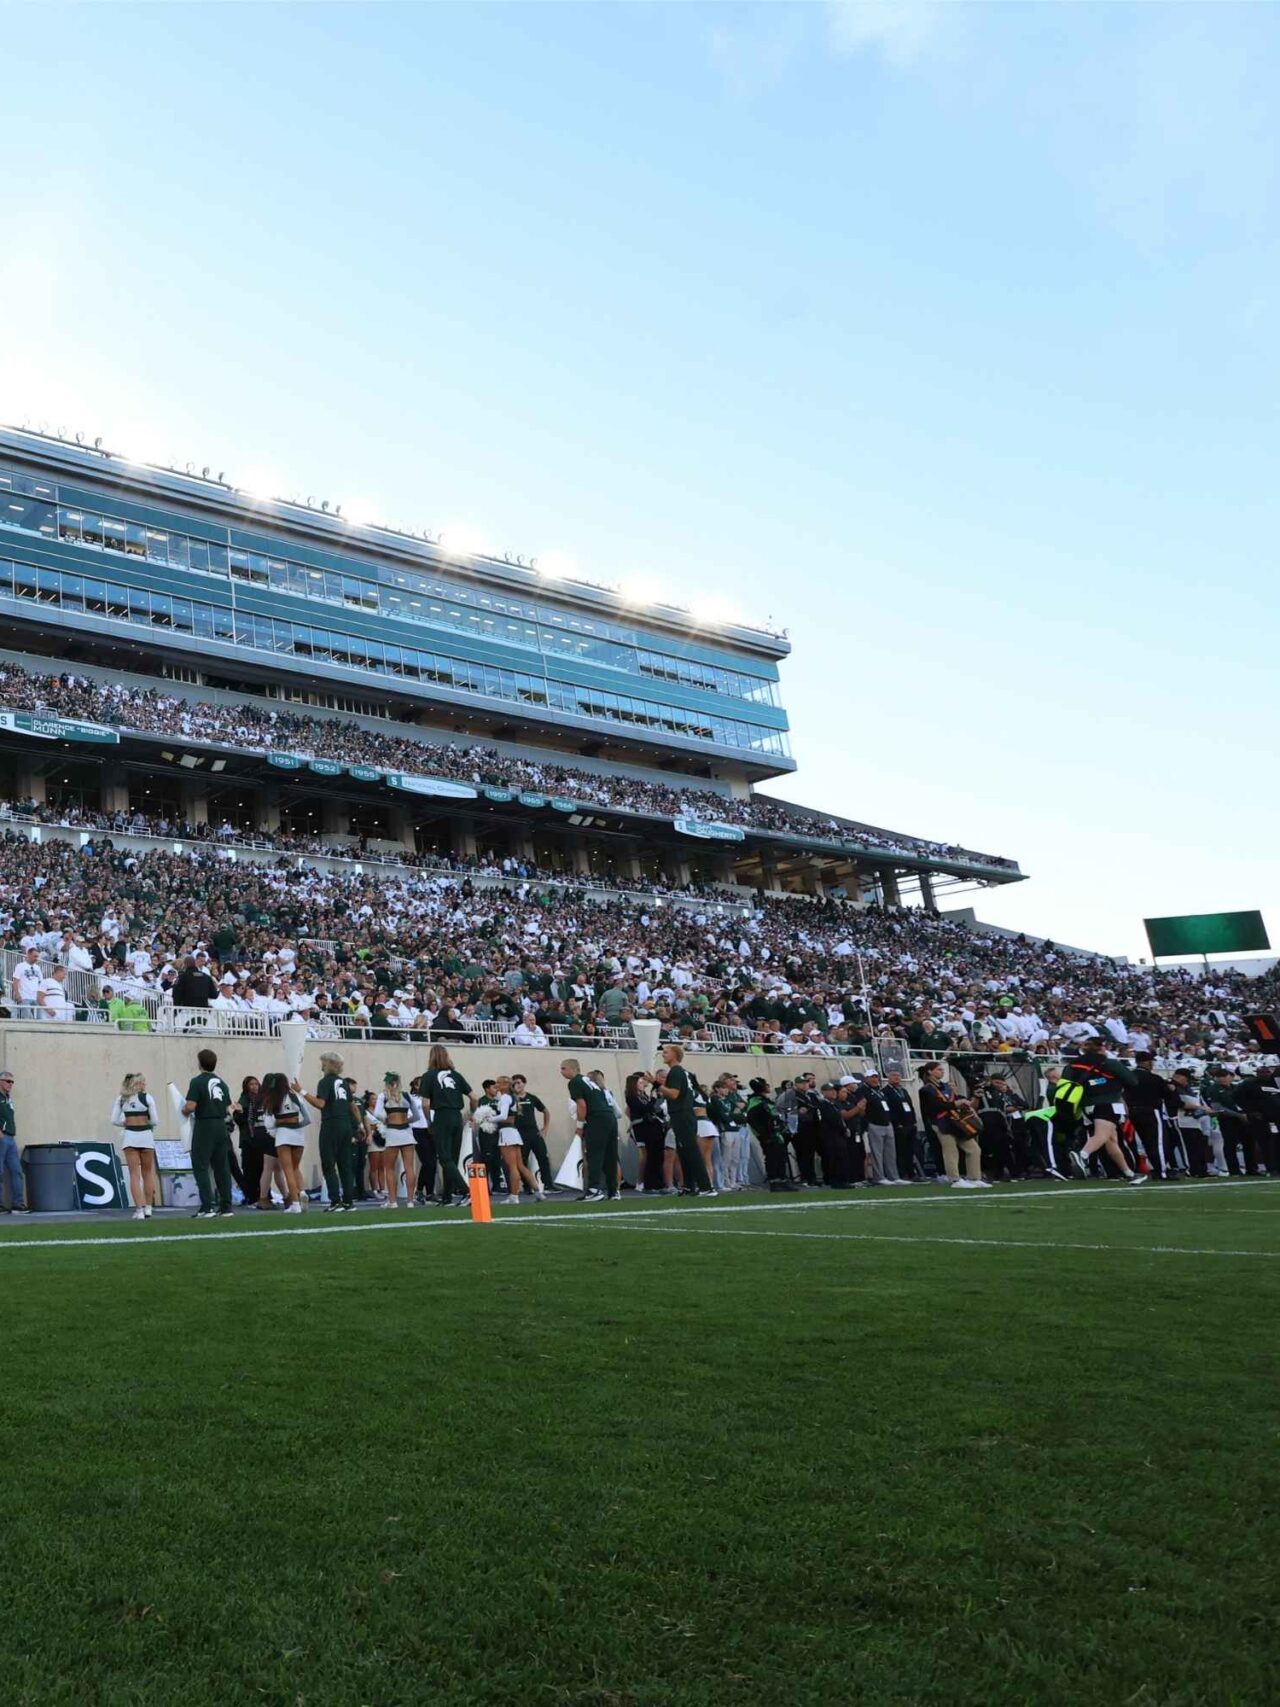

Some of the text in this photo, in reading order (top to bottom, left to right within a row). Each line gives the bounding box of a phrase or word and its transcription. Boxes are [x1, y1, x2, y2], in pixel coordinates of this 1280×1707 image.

[0, 716, 8, 725] S
[33, 720, 76, 731] CLARENCE
[33, 725, 66, 736] MUNN
[274, 756, 295, 766] 1951
[314, 763, 336, 772] 1952
[391, 777, 398, 785] S
[75, 1151, 115, 1205] S
